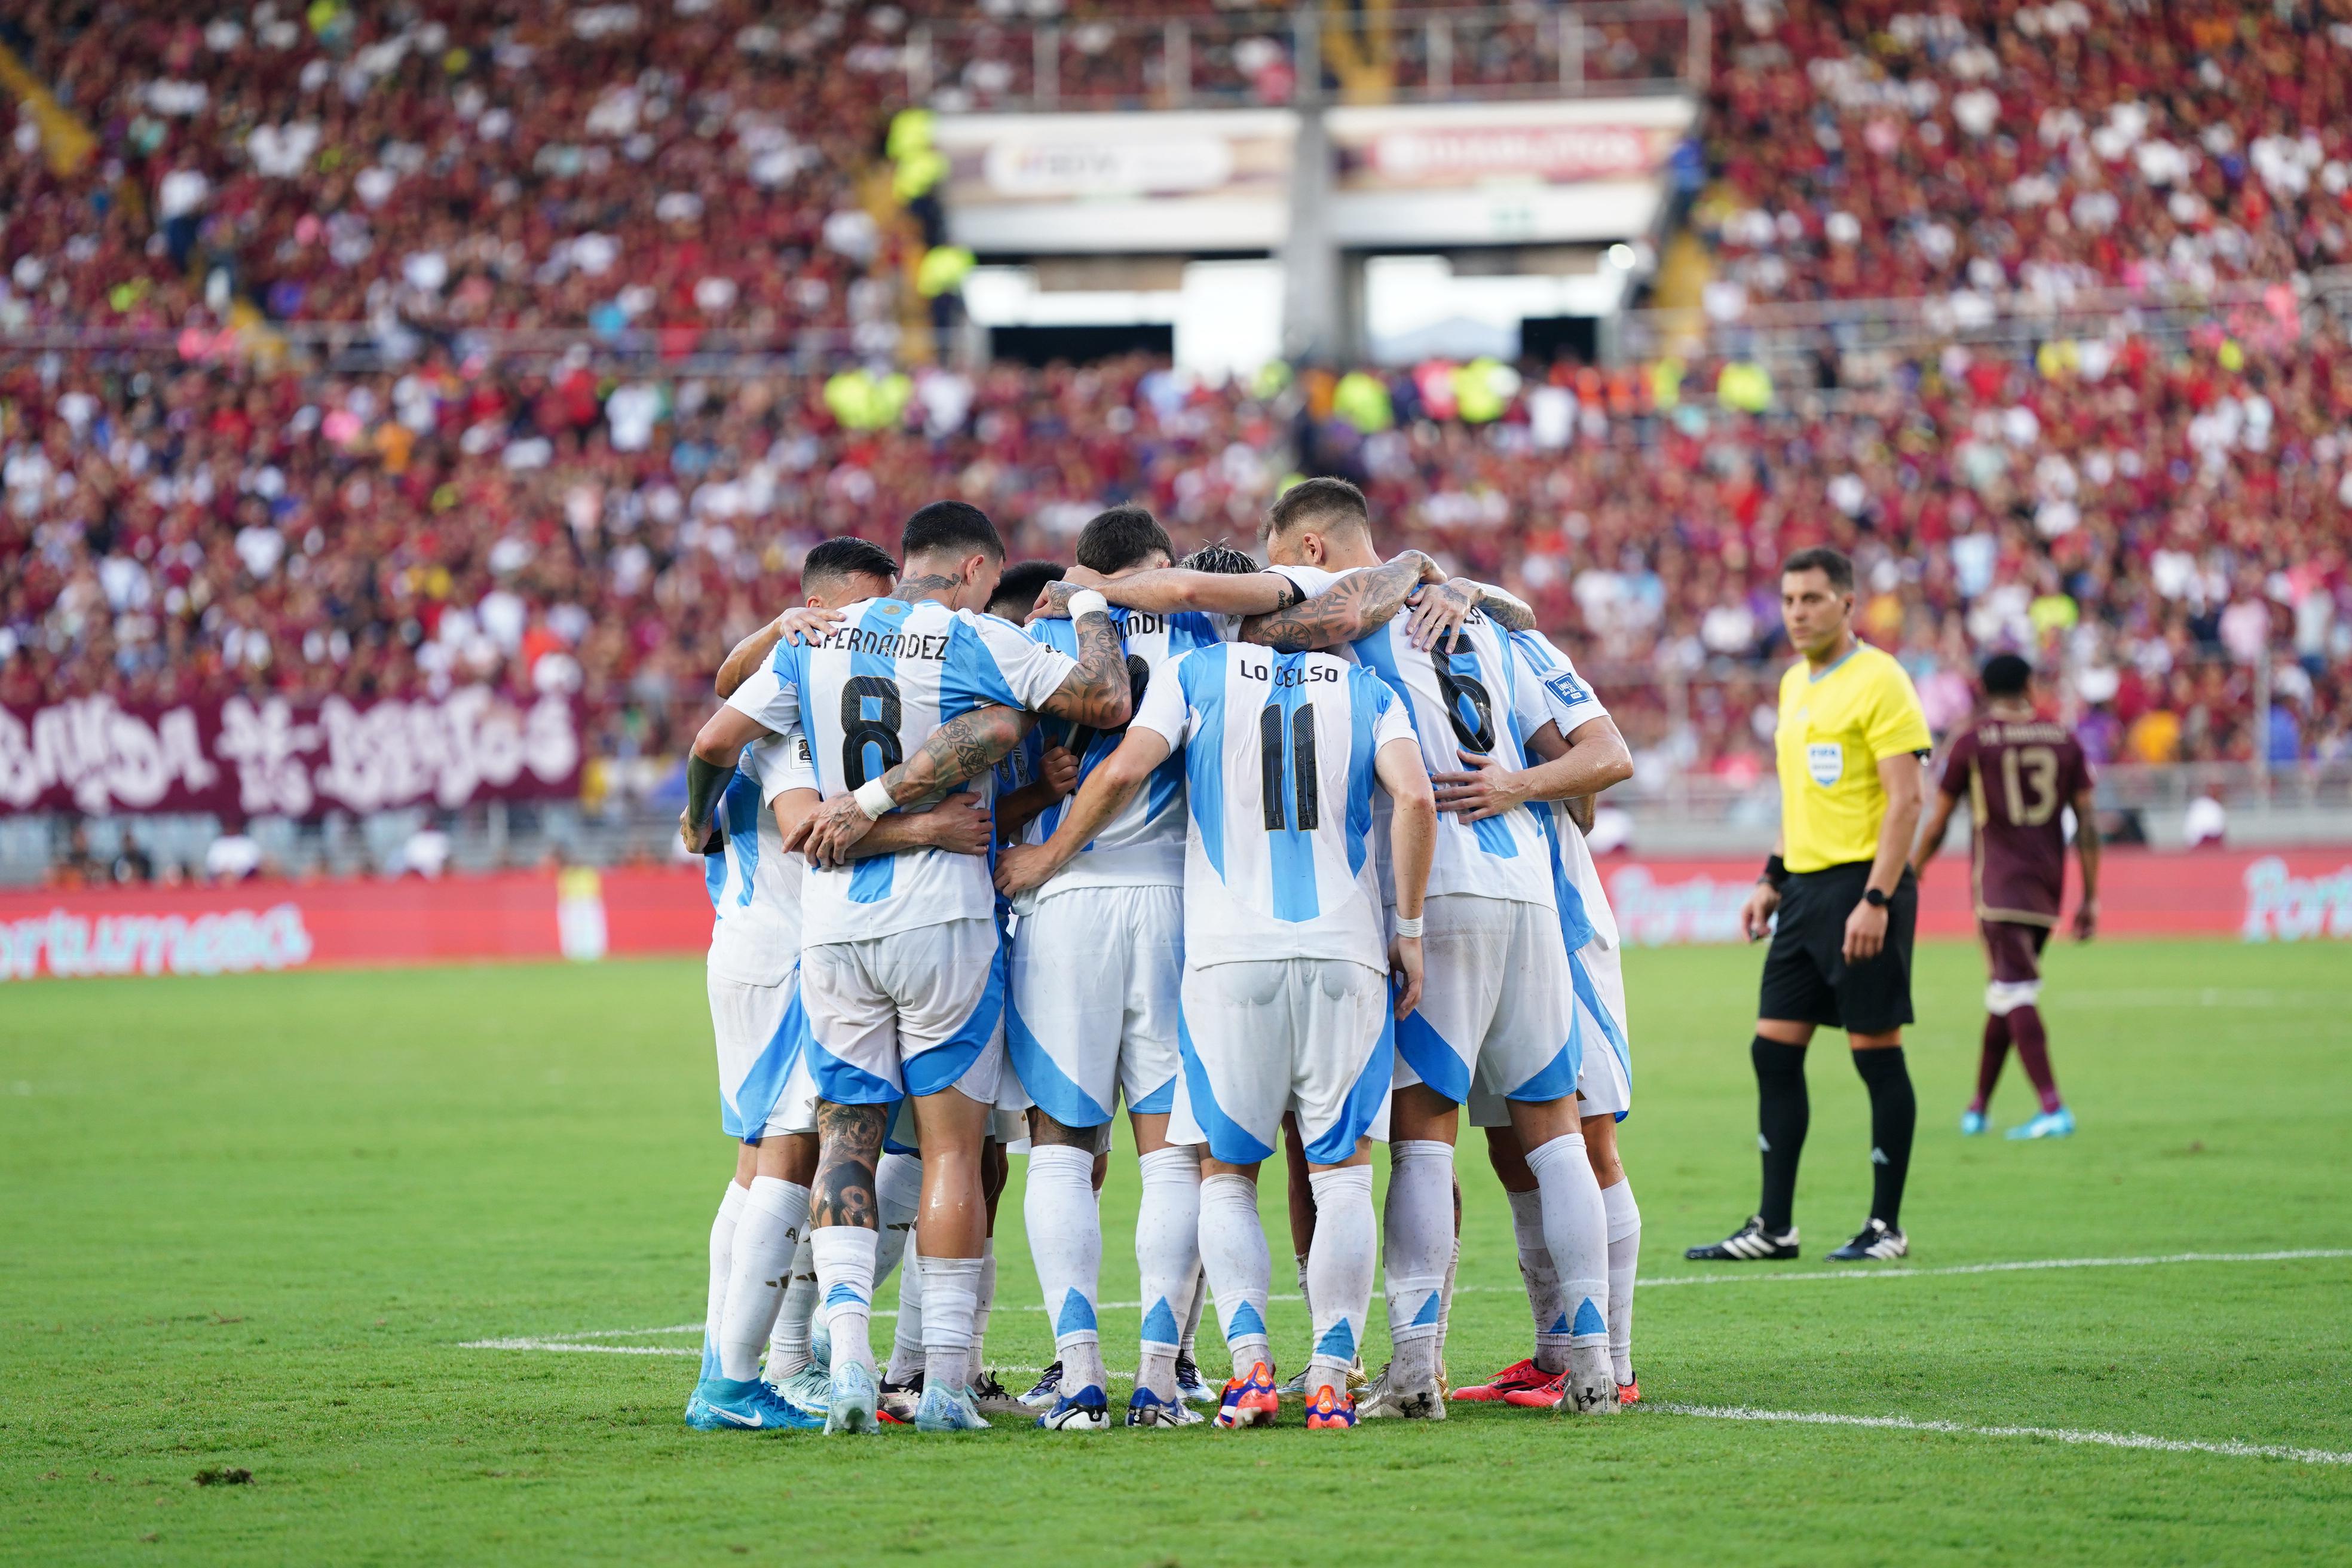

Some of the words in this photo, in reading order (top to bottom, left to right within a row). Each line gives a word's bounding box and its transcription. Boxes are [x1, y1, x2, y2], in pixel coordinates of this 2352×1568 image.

[1241, 659, 1268, 681] LO
[1275, 664, 1338, 688] CELSO
[1430, 632, 1496, 753] 6
[841, 675, 903, 792] 8
[1260, 702, 1319, 831] 11
[2002, 746, 2058, 826] 13
